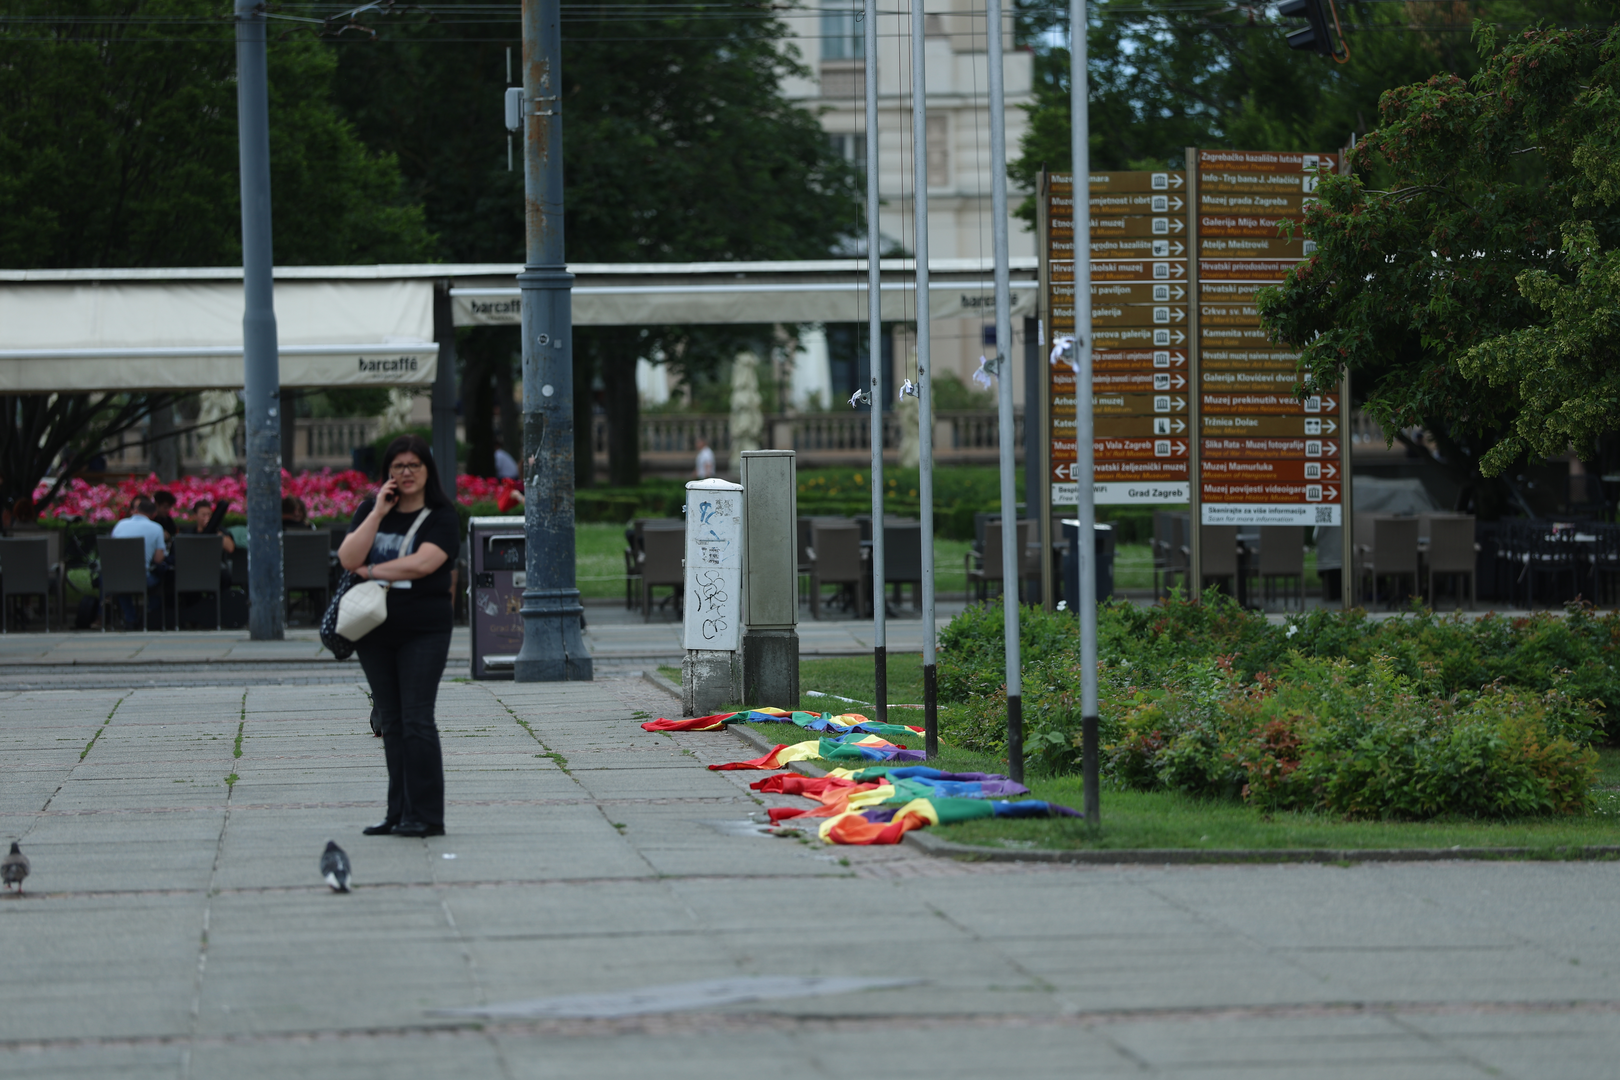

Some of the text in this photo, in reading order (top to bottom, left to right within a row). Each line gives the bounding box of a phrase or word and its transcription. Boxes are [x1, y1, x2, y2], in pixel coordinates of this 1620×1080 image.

[1238, 174, 1257, 183] bana
[1202, 195, 1287, 207] Muzej grada Zagreba
[1100, 219, 1125, 228] muzej
[1203, 218, 1236, 228] Galerija
[1238, 218, 1257, 228] Mijo
[1202, 240, 1226, 250] Atelje
[1118, 262, 1143, 272] muzej
[1202, 284, 1236, 292] Hrvatski
[472, 299, 521, 314] barcaff
[1202, 307, 1226, 315] Crkva
[1203, 329, 1242, 337] Kamenita
[1204, 373, 1235, 383] Galerija
[1276, 373, 1297, 382] dvori
[1099, 396, 1124, 406] muzej
[1204, 396, 1230, 405] Muzej
[1235, 418, 1258, 426] Dolac
[1106, 441, 1122, 449] Vala
[1124, 441, 1152, 450] Zagreb
[1205, 440, 1222, 448] Slika
[1224, 440, 1240, 448] Rata
[1246, 440, 1267, 450] Muzej
[1163, 462, 1186, 472] muzej
[1204, 462, 1227, 472] Muzej
[1128, 489, 1183, 498] Grad Zagreb
[1204, 484, 1228, 494] Muzej
[1230, 484, 1263, 494] povijesti
[1208, 507, 1242, 515] Skenirajte
